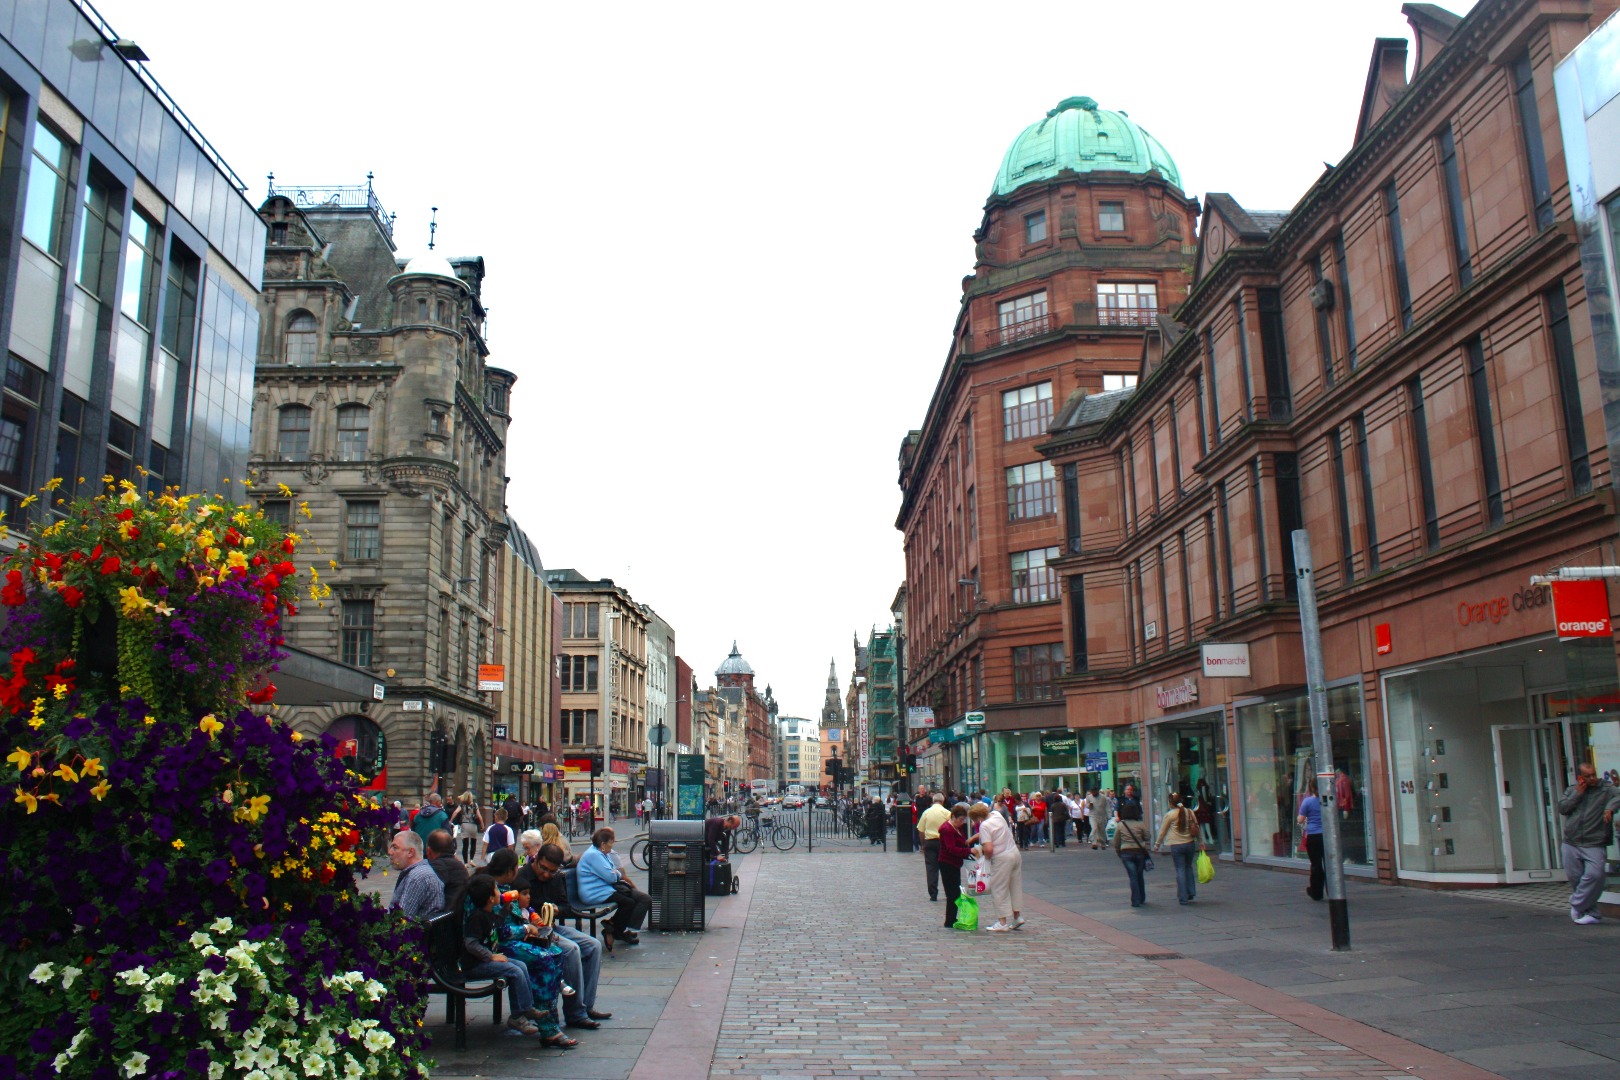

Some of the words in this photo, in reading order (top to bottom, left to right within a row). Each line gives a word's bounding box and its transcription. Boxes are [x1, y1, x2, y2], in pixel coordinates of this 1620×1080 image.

[1457, 596, 1509, 626] Orange
[1512, 586, 1552, 612] clear
[522, 764, 534, 772] JD
